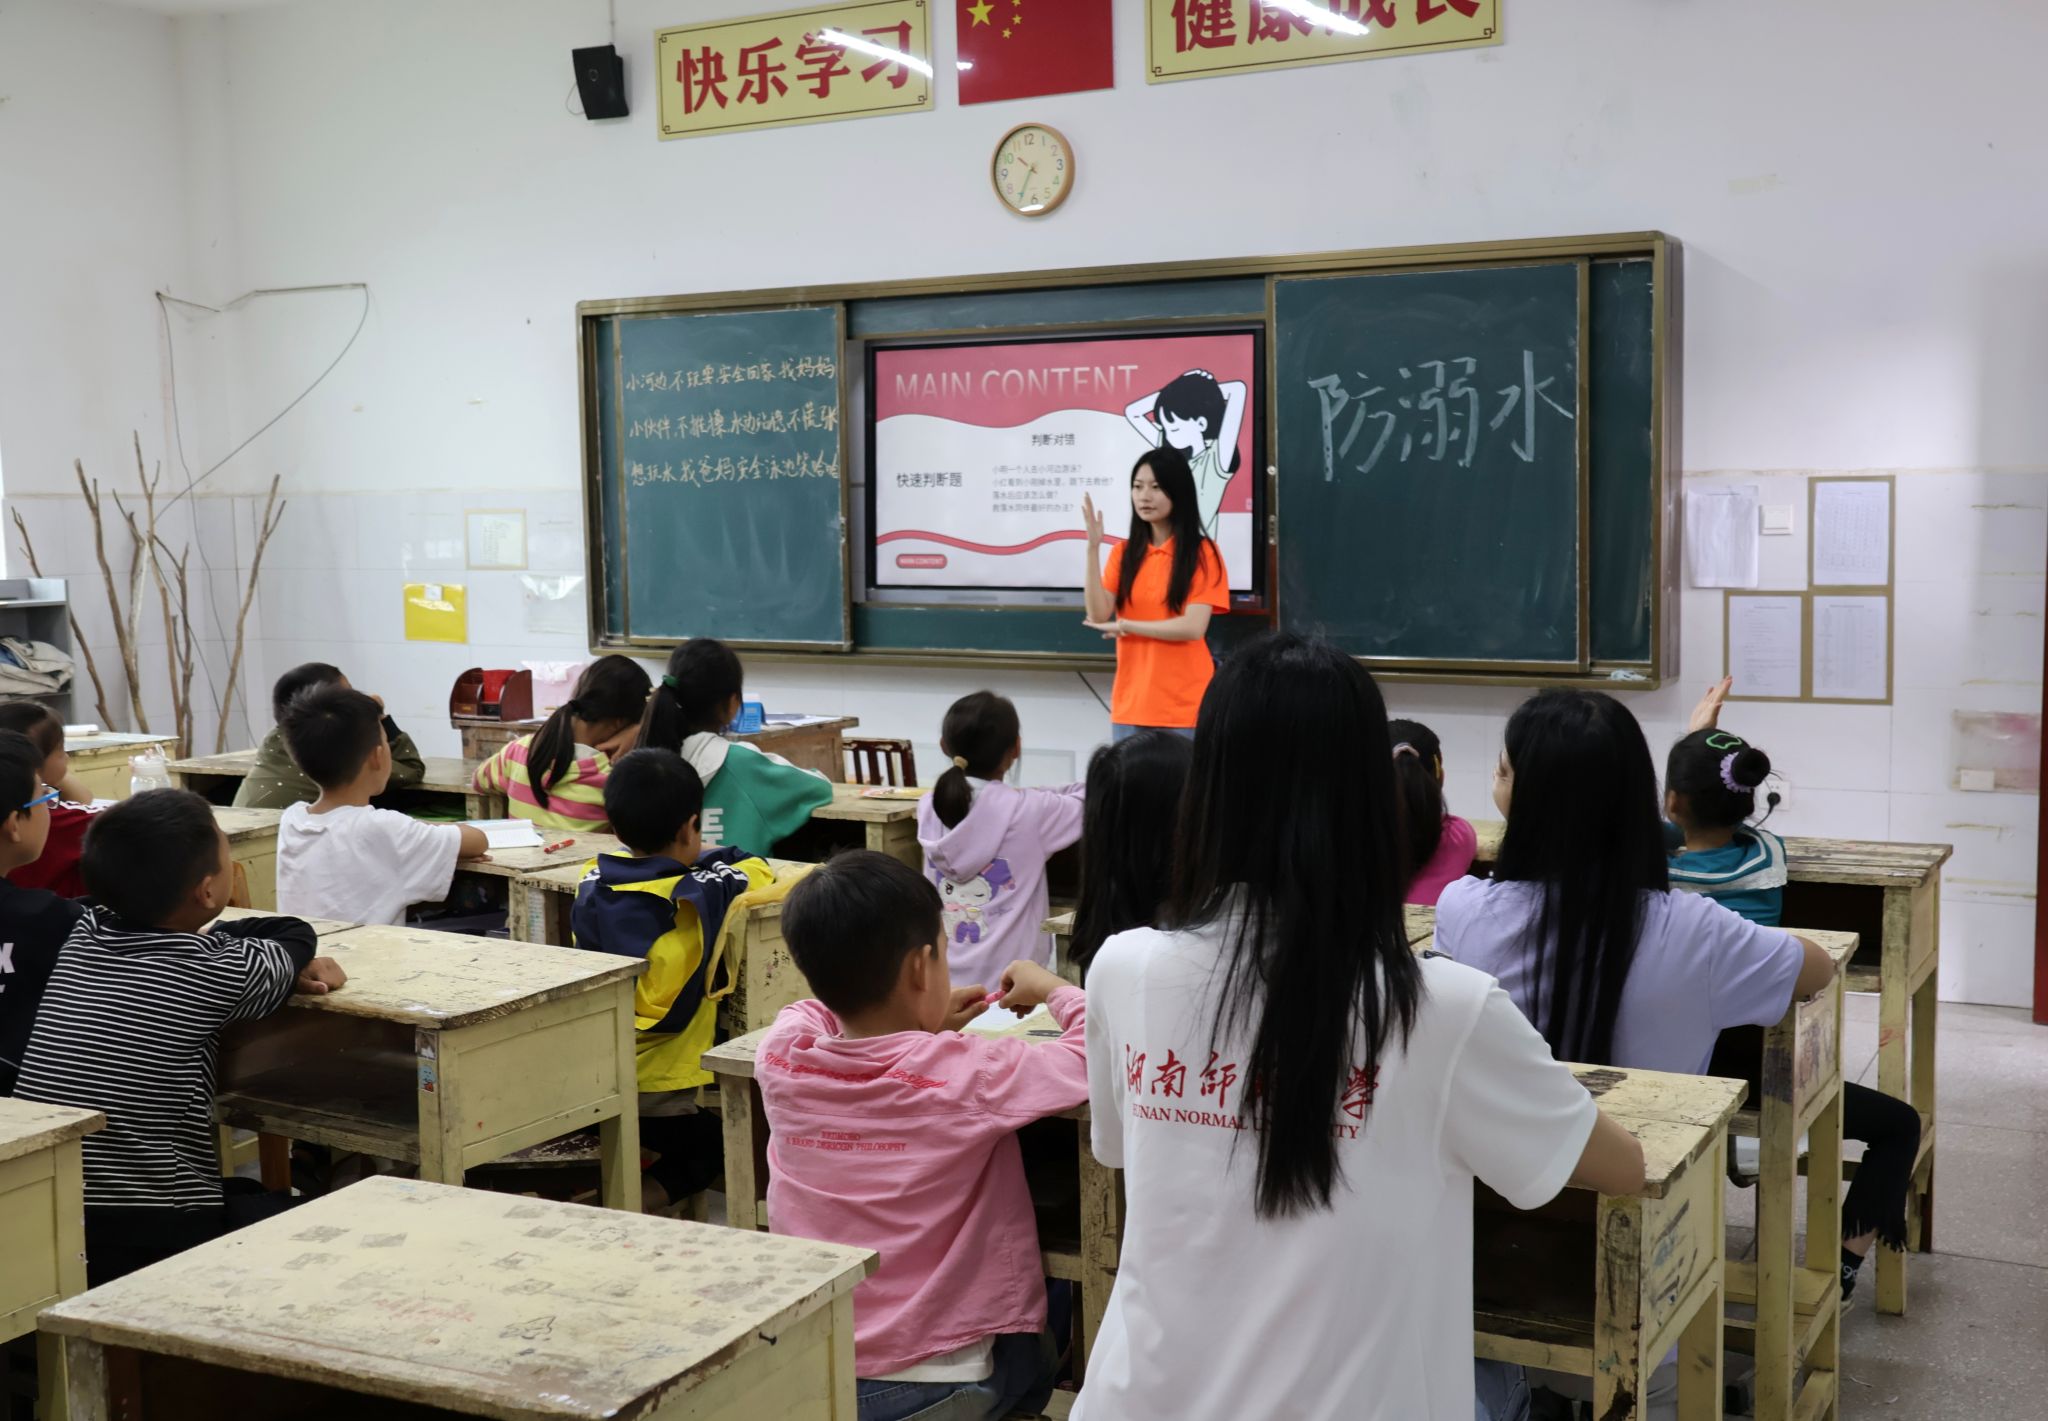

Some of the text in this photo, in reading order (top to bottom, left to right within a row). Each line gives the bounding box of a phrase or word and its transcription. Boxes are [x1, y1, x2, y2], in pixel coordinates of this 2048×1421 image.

[676, 20, 913, 115] 快乐学习
[1024, 133, 1035, 146] 12
[1056, 158, 1064, 171] 3
[895, 365, 1139, 400] MAIN CONTENT
[1307, 349, 1574, 482] 防溺水
[1031, 433, 1075, 447] 判断对错
[896, 472, 963, 489] 快速判断题
[1174, 1109, 1248, 1131] NORMAL
